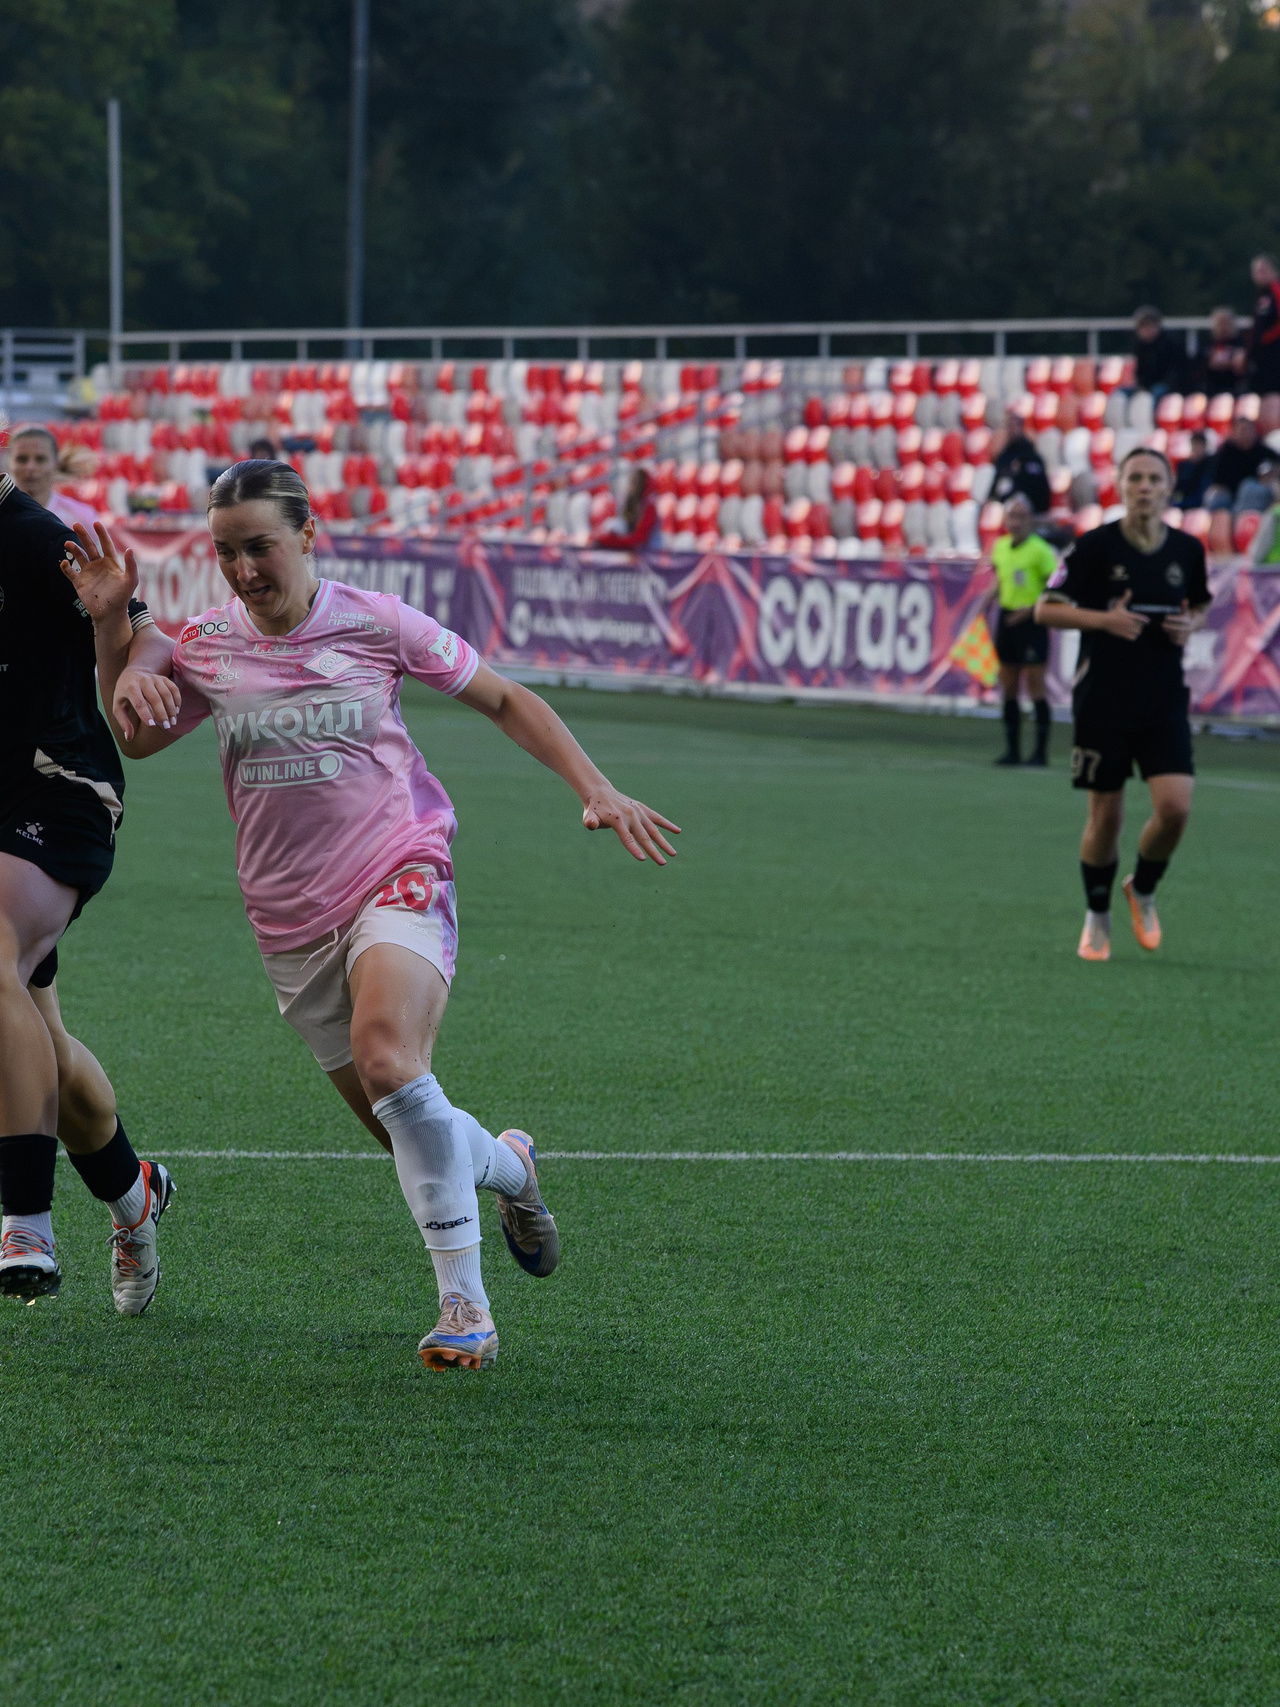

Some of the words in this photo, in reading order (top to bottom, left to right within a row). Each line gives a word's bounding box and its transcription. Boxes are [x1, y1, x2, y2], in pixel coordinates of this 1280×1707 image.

[330, 611, 375, 622] КИБЕР
[197, 621, 229, 637] 100
[328, 618, 393, 636] ПРОТЕКТ
[242, 759, 317, 782] WINLINE
[16, 828, 44, 846] KELME
[422, 1216, 473, 1231] JÖGEL
